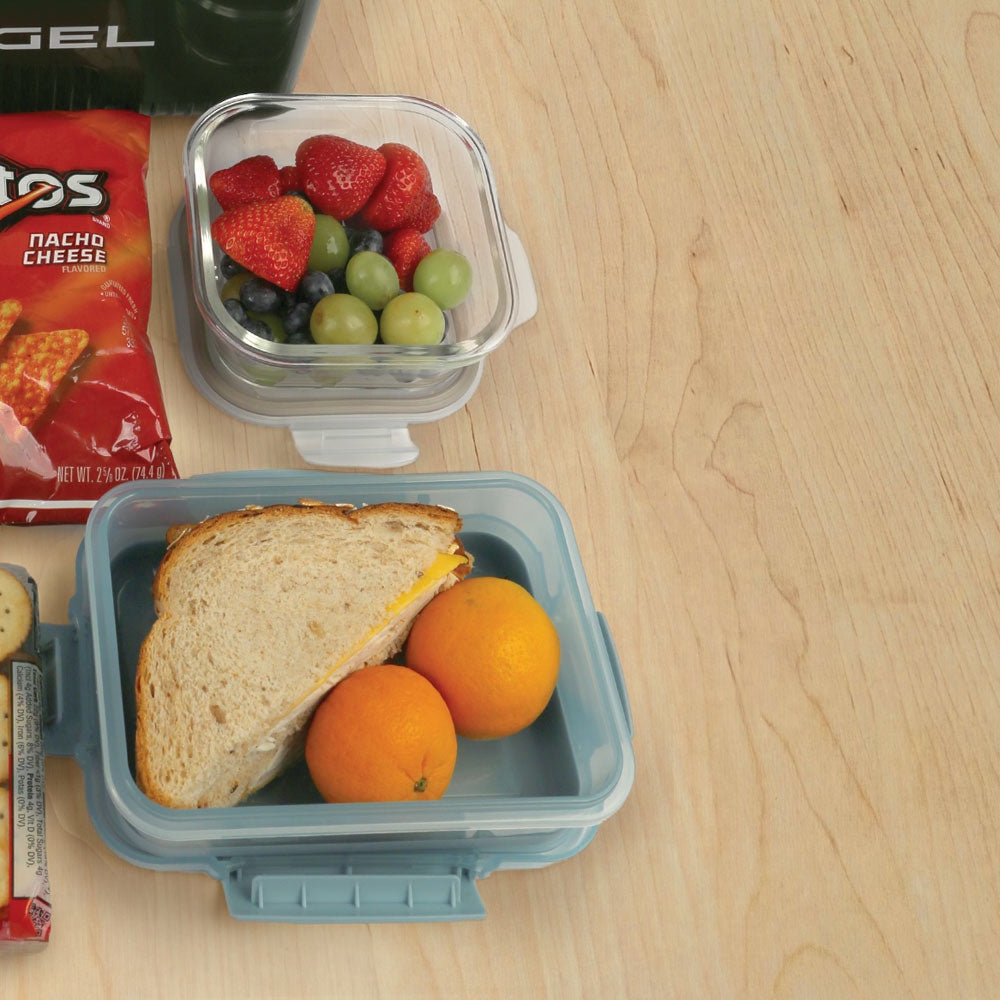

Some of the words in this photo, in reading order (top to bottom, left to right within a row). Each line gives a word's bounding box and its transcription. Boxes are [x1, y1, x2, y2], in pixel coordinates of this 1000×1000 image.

[29, 232, 104, 248] NACHO
[23, 249, 106, 265] CHEESE
[62, 265, 106, 273] FLAVORED
[57, 466, 74, 483] NET
[77, 466, 94, 483] WT.
[114, 466, 129, 481] OZ.
